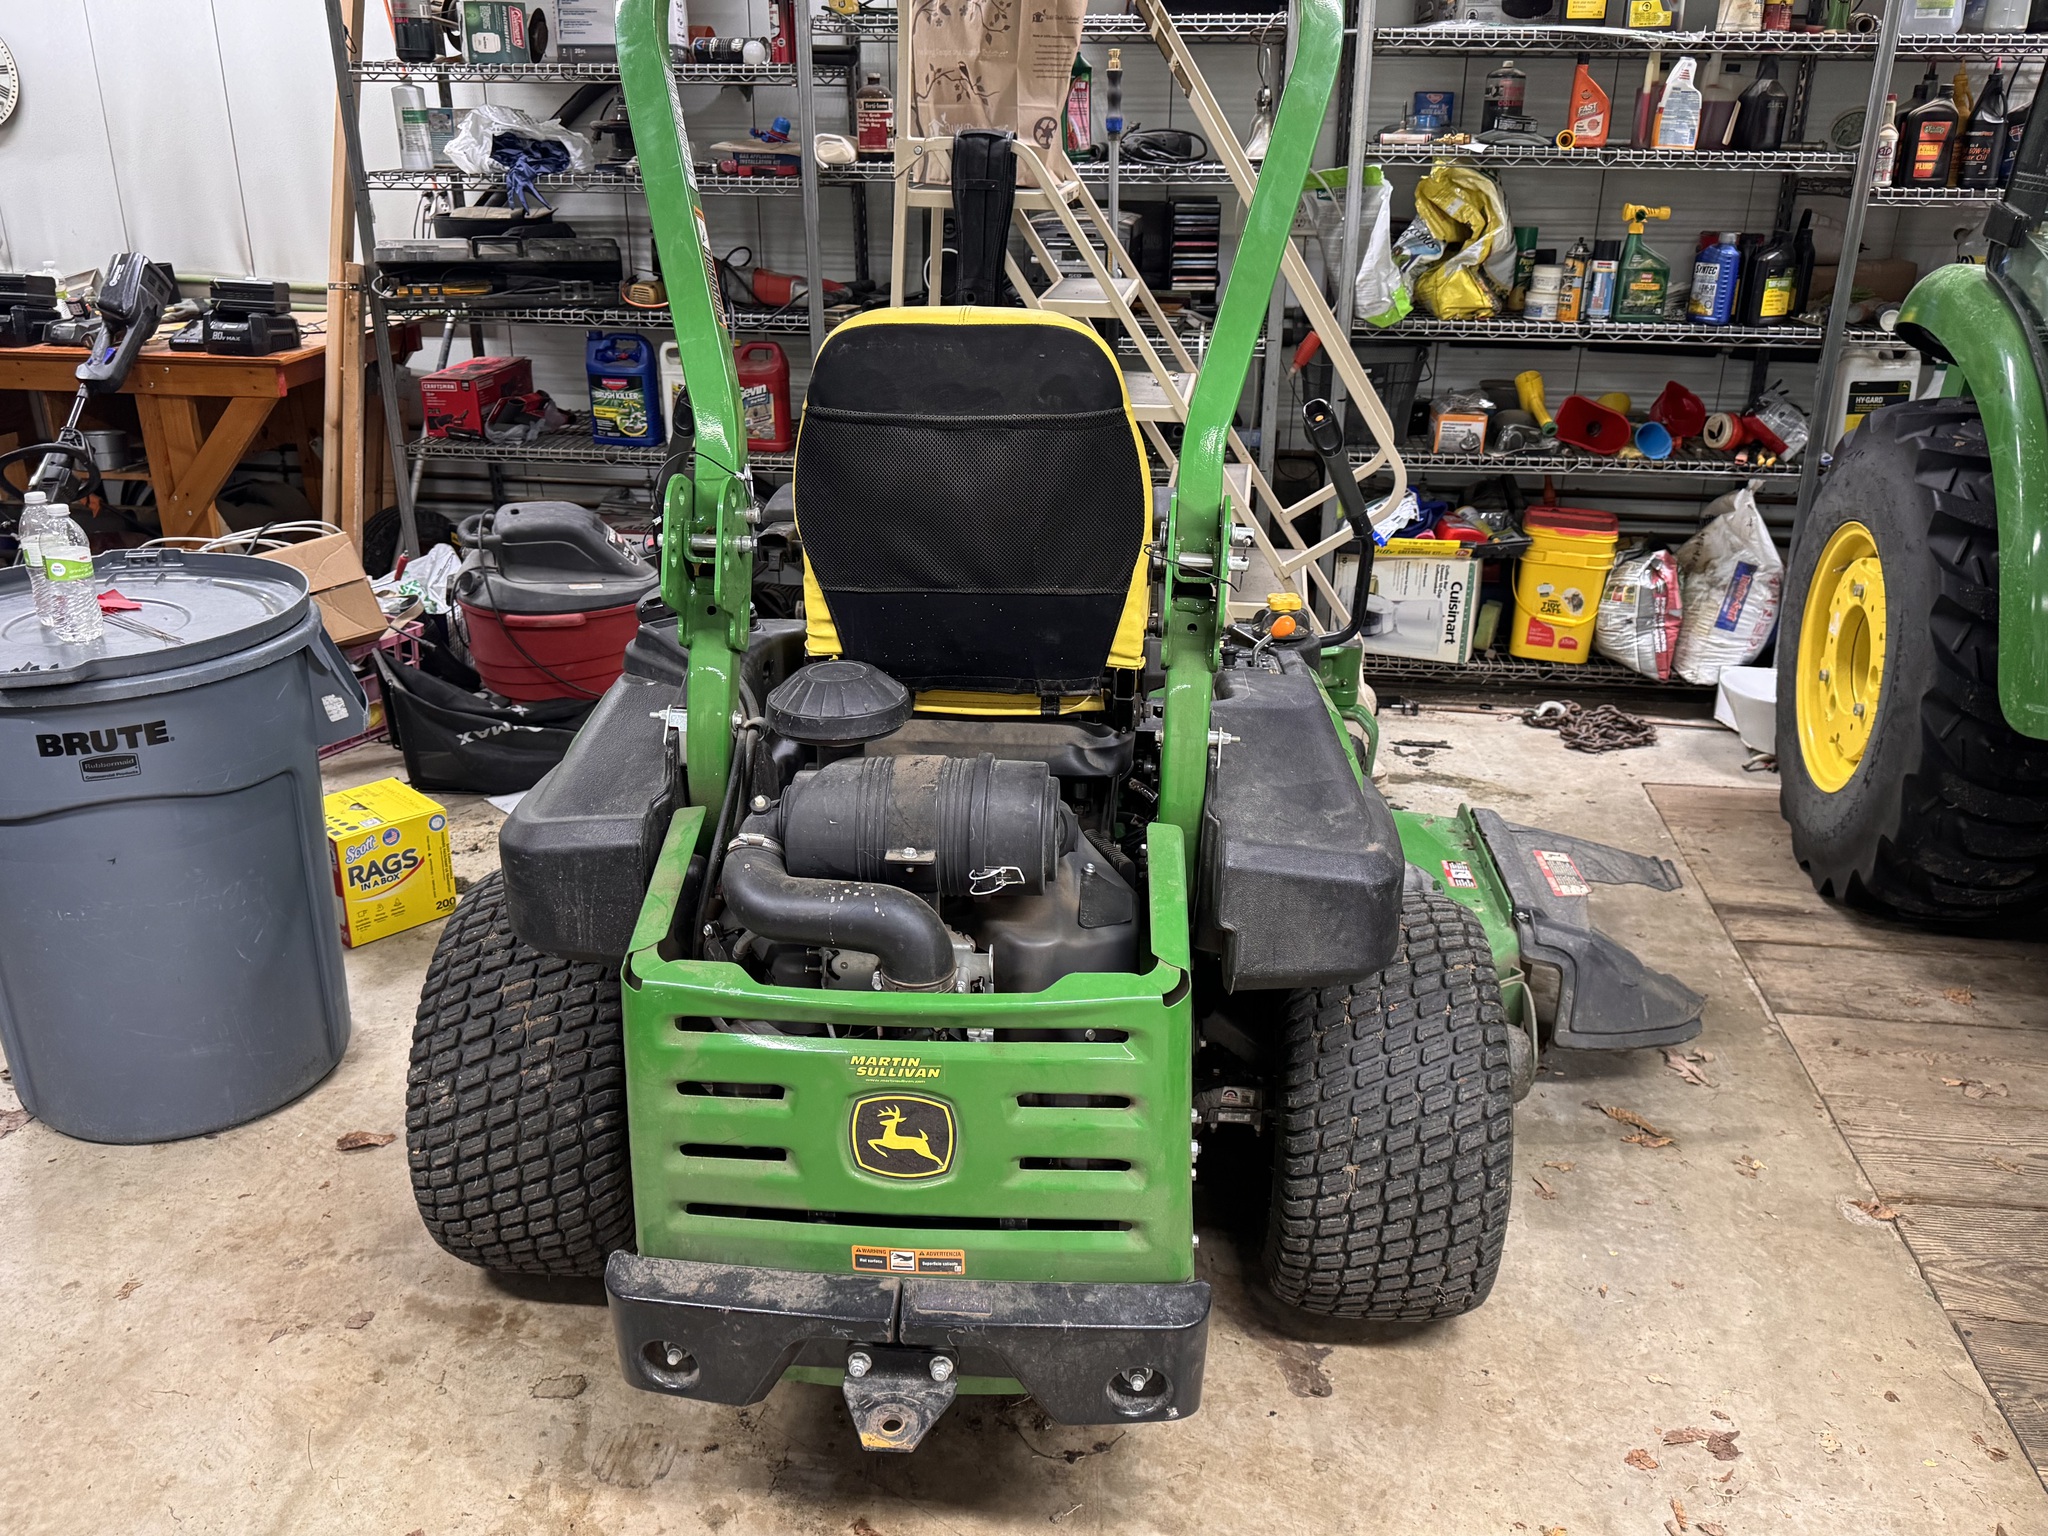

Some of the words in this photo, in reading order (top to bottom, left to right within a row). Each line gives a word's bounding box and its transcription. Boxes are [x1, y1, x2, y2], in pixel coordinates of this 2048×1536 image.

[511, 10, 522, 39] Coleman
[1579, 103, 1598, 111] FAST
[1915, 162, 1933, 170] FLUID
[1694, 264, 1718, 275] SYNTEC
[594, 391, 615, 400] BRUSH
[616, 392, 639, 400] KILLER
[1855, 396, 1883, 404] HY-GARD
[1444, 581, 1463, 645] Cuisinart
[36, 720, 170, 758] BRUTE
[84, 758, 135, 770] Rubbermaid
[85, 772, 115, 780] Commercial
[116, 769, 139, 777] Products
[345, 834, 378, 864] Scott
[347, 848, 419, 888] RAGS
[361, 882, 371, 892] IN
[372, 878, 380, 887] A
[381, 874, 400, 886] BOX
[435, 896, 456, 910] 200
[850, 1055, 920, 1067] MARTIN
[856, 1066, 941, 1078] SULLIVAN
